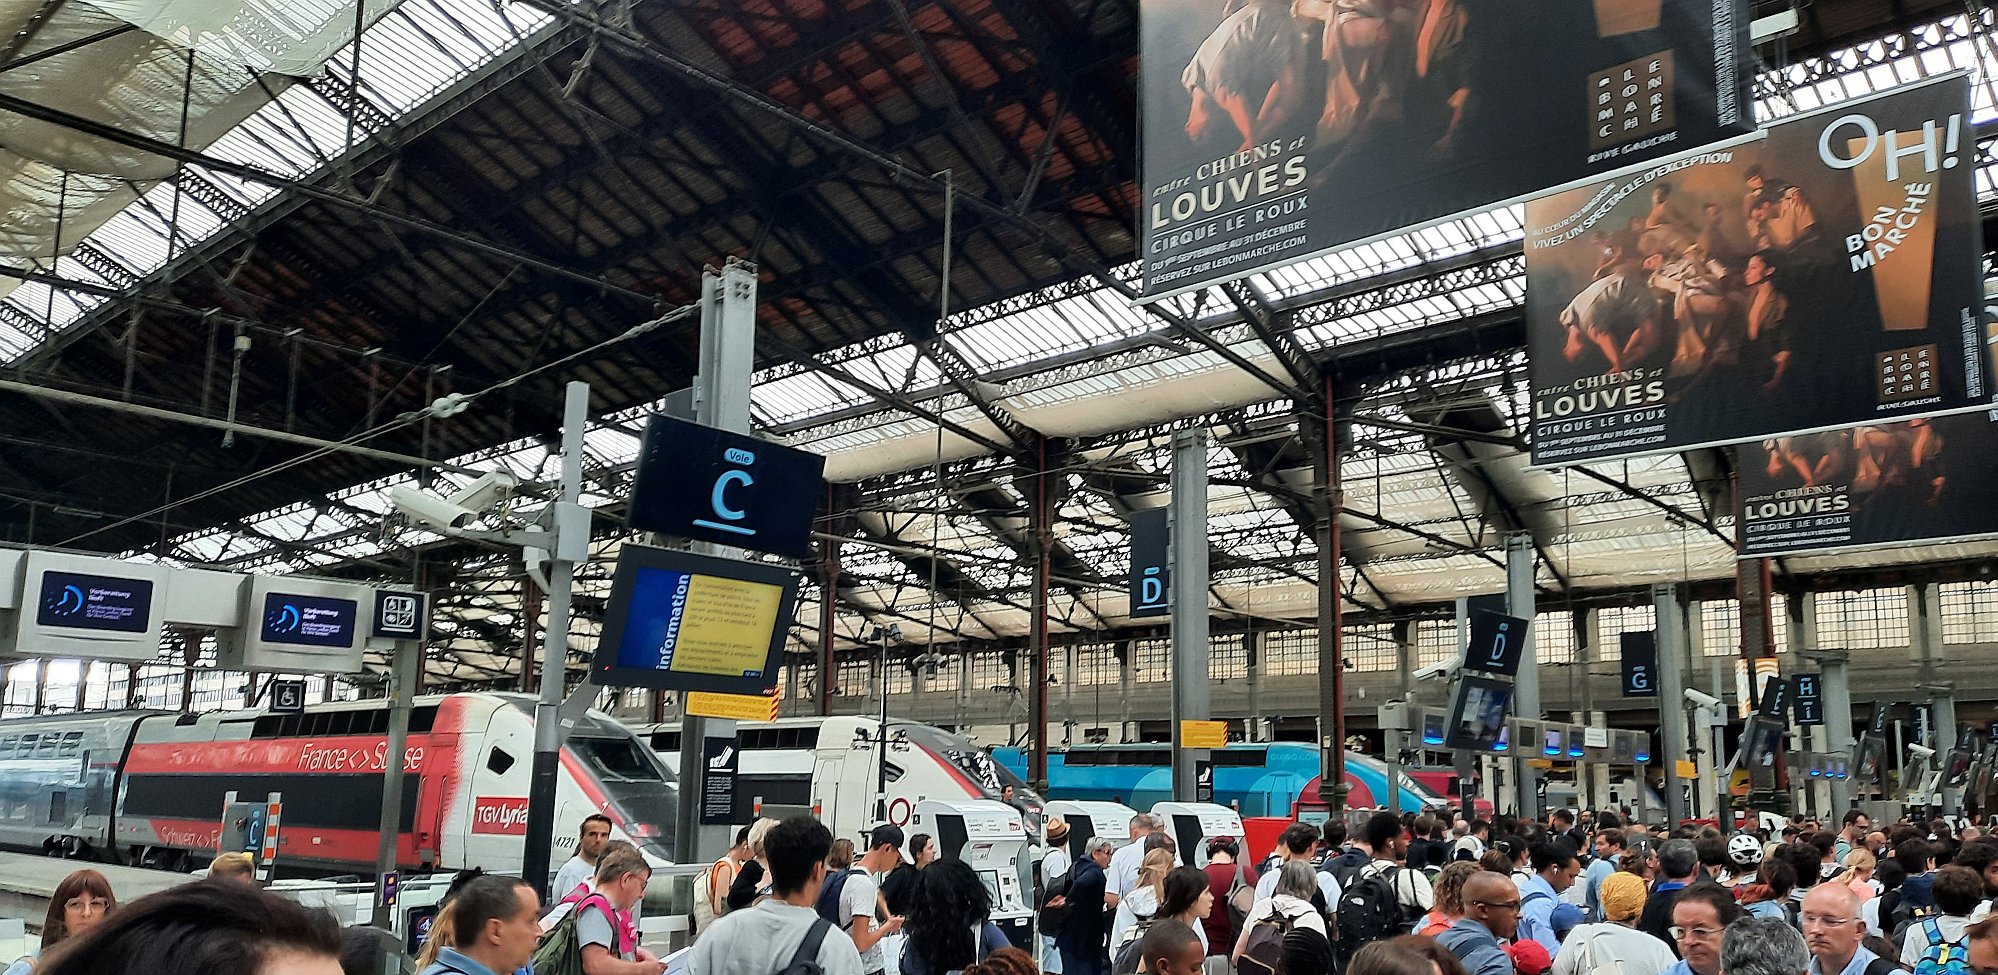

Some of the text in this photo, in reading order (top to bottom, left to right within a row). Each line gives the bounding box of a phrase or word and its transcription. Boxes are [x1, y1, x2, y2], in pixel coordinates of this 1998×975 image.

[1587, 131, 1679, 164] RIVE GAUCHE
[1818, 112, 1962, 182] OH!
[1152, 135, 1306, 197] entre CHIENS et
[1151, 154, 1308, 230] LOUVES
[1532, 151, 1734, 250] VIVEZ UN SPECTACLE D'EXCEPTION
[1150, 194, 1309, 254] CIRQUE LE ROUX
[1845, 205, 1899, 254] BON
[1150, 234, 1307, 286] RÉSERVEZ SUR LEBONMARCHE.COM
[1151, 260, 1164, 272] DU
[1177, 241, 1229, 263] SEPTEMBRE
[1229, 237, 1244, 249] AU
[1243, 234, 1254, 246] 31
[1254, 218, 1308, 242] DÉCEMBRE
[1536, 367, 1663, 397] entre CHIENS et
[1536, 380, 1666, 420] LOUVES
[1536, 408, 1667, 437] CIRQUE LE ROUX
[711, 469, 755, 521] C
[1744, 494, 1850, 521] LOUVES
[1774, 484, 1833, 500] CHIENS
[1746, 521, 1793, 534] CIRQUE
[1815, 515, 1851, 527] ROUX
[1142, 577, 1162, 604] D
[656, 574, 691, 671] information
[1491, 633, 1506, 660] D
[1632, 672, 1648, 688] G
[1799, 682, 1813, 695] H
[297, 742, 348, 770] France
[477, 803, 528, 830] TGV Lyria
